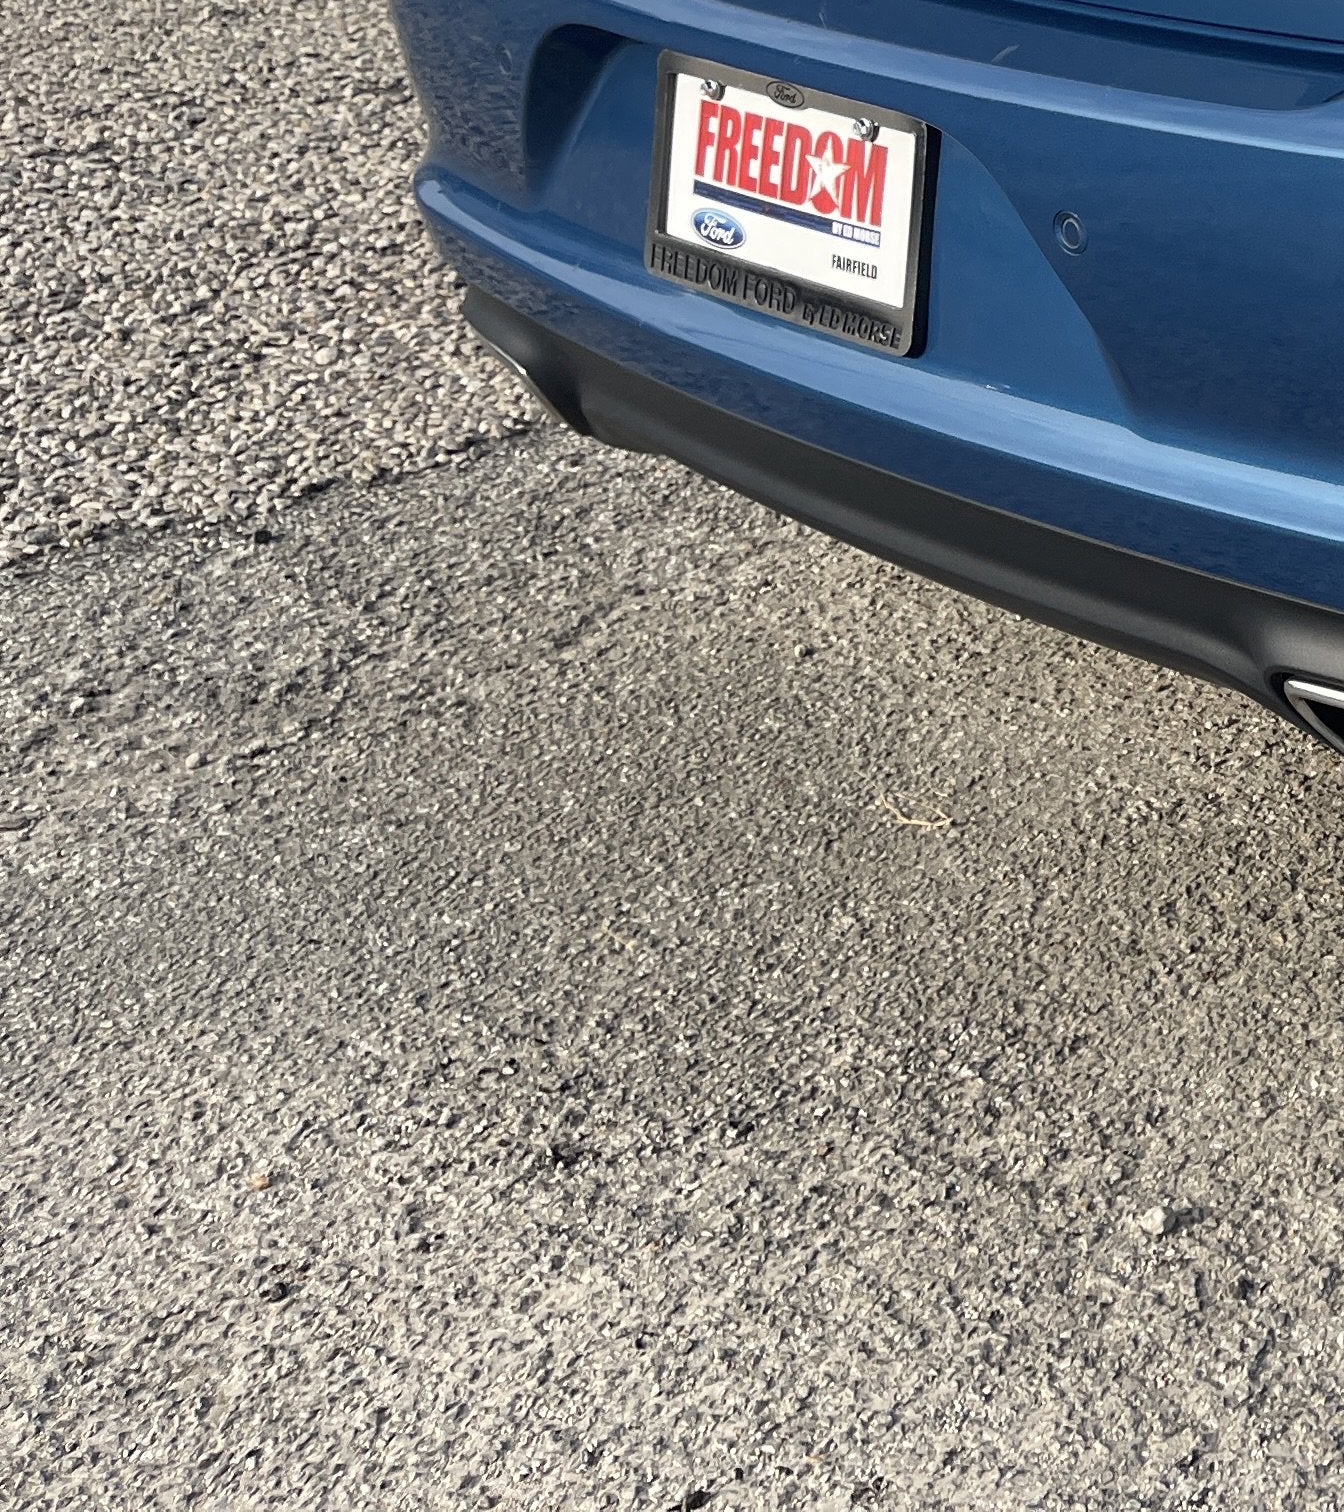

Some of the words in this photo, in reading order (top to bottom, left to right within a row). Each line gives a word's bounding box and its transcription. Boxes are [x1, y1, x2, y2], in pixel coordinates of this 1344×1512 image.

[772, 85, 797, 105] Ford
[695, 99, 888, 226] FREEDOM
[700, 213, 737, 246] Ford
[832, 254, 878, 279] FAIRFIELD
[650, 243, 738, 297] FREEDOM
[742, 271, 797, 314] FORD
[842, 311, 902, 350] MORSE
